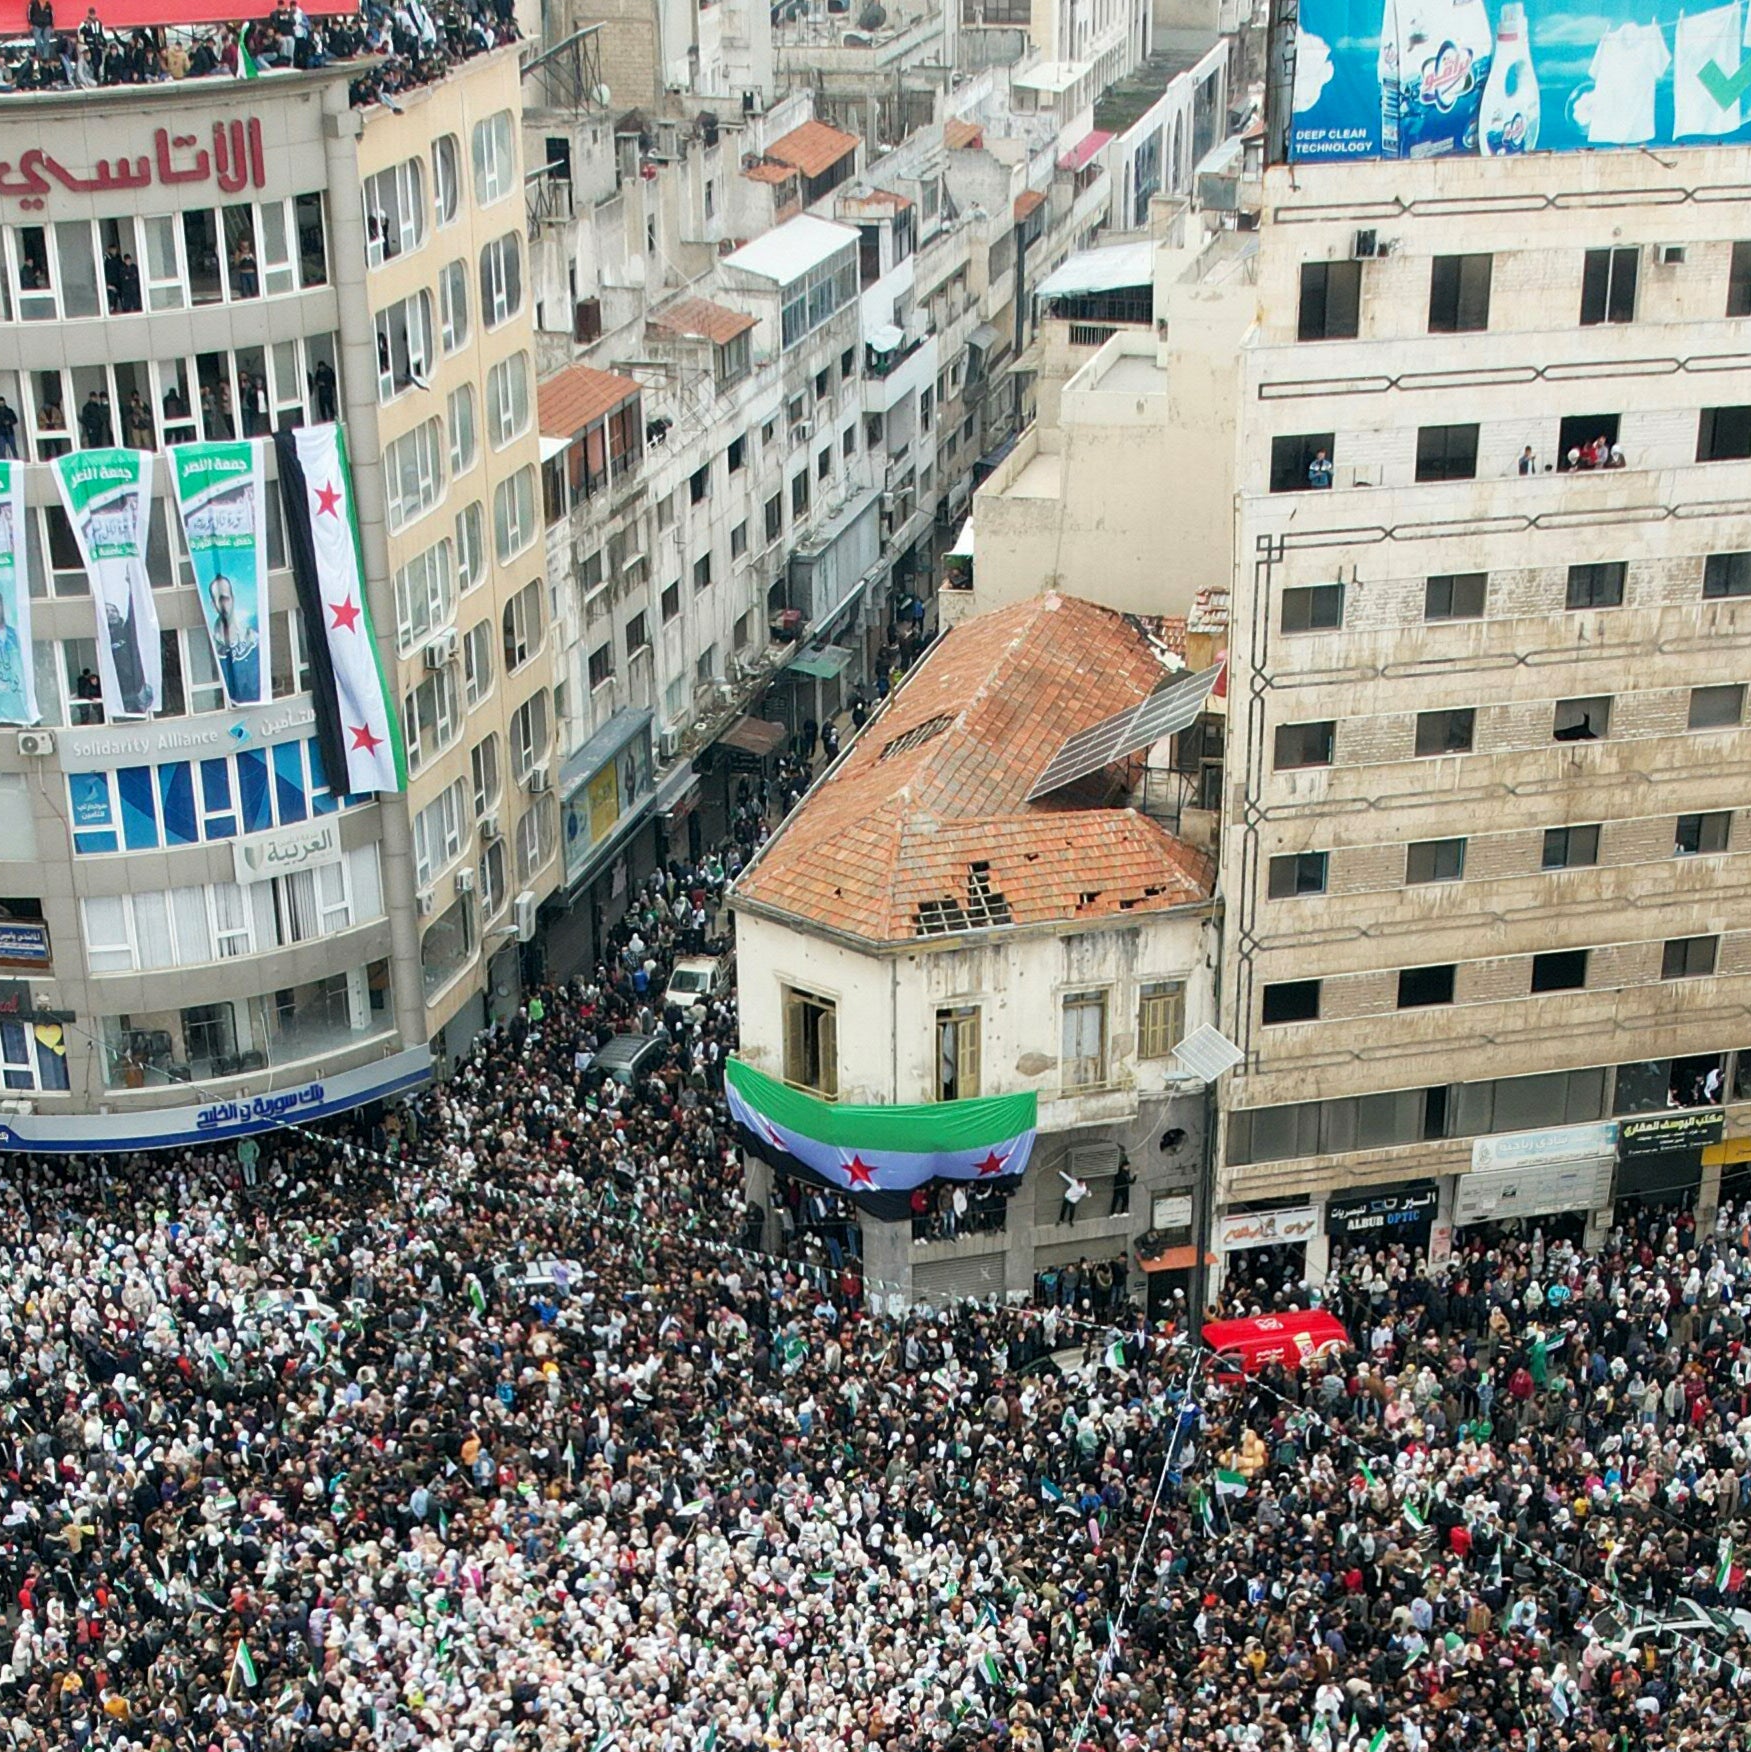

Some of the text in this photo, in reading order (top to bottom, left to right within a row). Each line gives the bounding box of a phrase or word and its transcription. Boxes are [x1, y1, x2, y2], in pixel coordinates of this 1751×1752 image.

[1296, 128, 1367, 140] DEEP CLEAN
[1295, 142, 1373, 154] TECHNOLOGY
[73, 728, 218, 758] Solidarity Alliance
[266, 828, 333, 866] العربية
[299, 1084, 325, 1104] بنك
[253, 1093, 299, 1117] سورية
[1696, 1114, 1724, 1128] مكتب
[1346, 1209, 1421, 1231] ALBUR OPTIC
